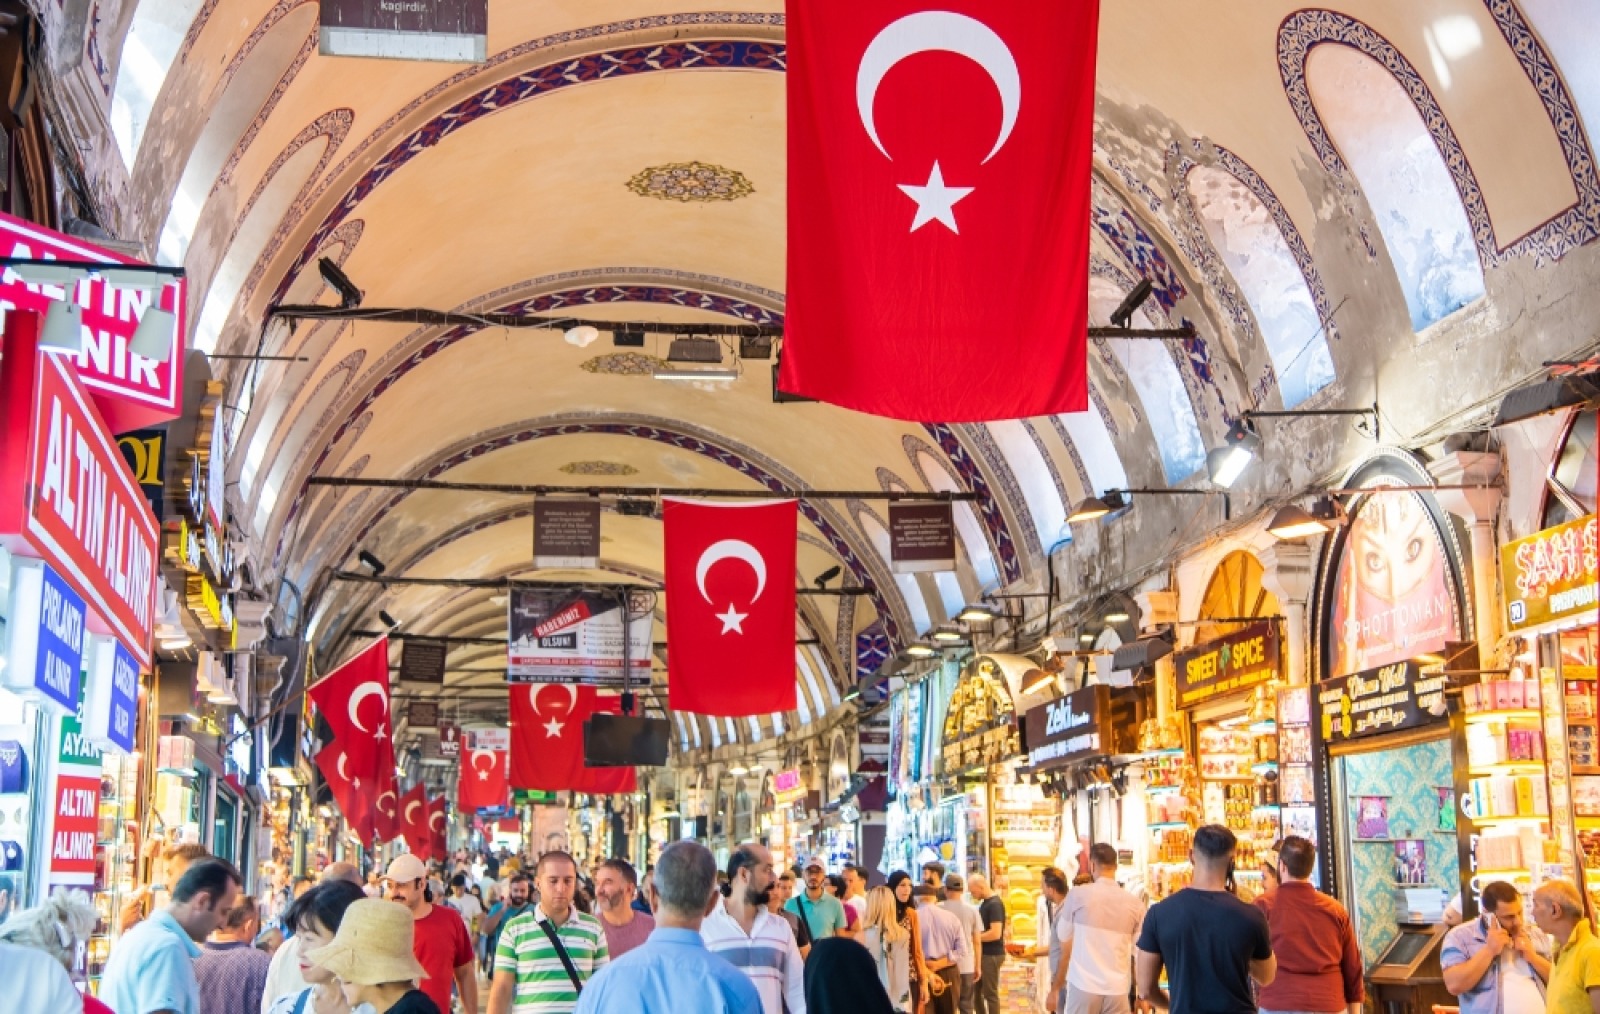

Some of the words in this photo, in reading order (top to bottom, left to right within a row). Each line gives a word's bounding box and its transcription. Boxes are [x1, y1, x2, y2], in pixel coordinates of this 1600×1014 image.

[42, 394, 108, 569] ALTIN
[105, 490, 152, 634] ALINIR
[42, 580, 82, 655] PIRLANTA
[541, 636, 572, 647] OLSUN!
[44, 650, 72, 700] ALINIR
[1186, 651, 1218, 685] SWEET
[1232, 636, 1265, 670] SPICE
[59, 788, 96, 818] ALTIN
[53, 831, 94, 860] ALINIR
